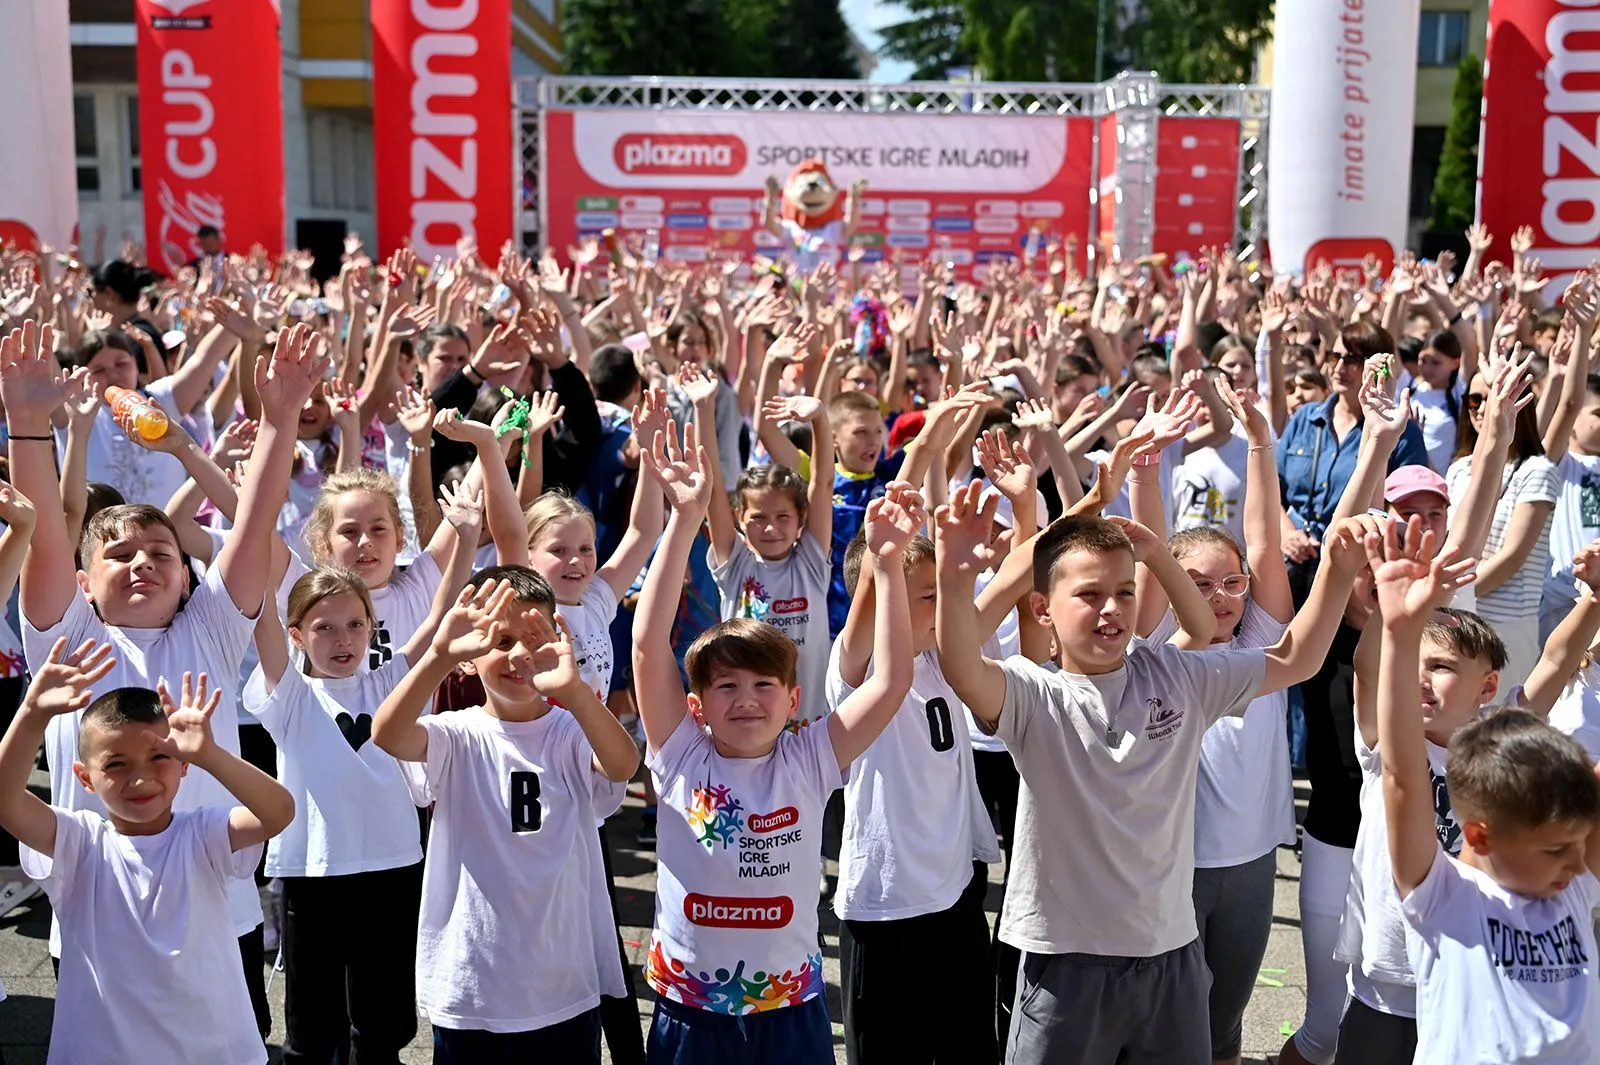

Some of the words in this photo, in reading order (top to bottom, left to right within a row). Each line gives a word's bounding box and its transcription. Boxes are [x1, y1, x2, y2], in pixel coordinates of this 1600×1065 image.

[161, 48, 218, 179] CUP
[624, 139, 732, 169] plazma
[757, 145, 873, 167] SPORTSKE
[879, 147, 931, 168] IGRE
[938, 148, 1029, 168] MLADIH
[1338, 113, 1365, 202] imate
[1148, 726, 1173, 740] SUMMER
[510, 771, 542, 833] B
[752, 812, 792, 830] plazma
[739, 829, 802, 850] SPORTSKE
[739, 851, 770, 864] IGRE
[738, 862, 790, 878] MLADIH
[692, 901, 782, 921] plazma
[1518, 968, 1538, 982] ARE
